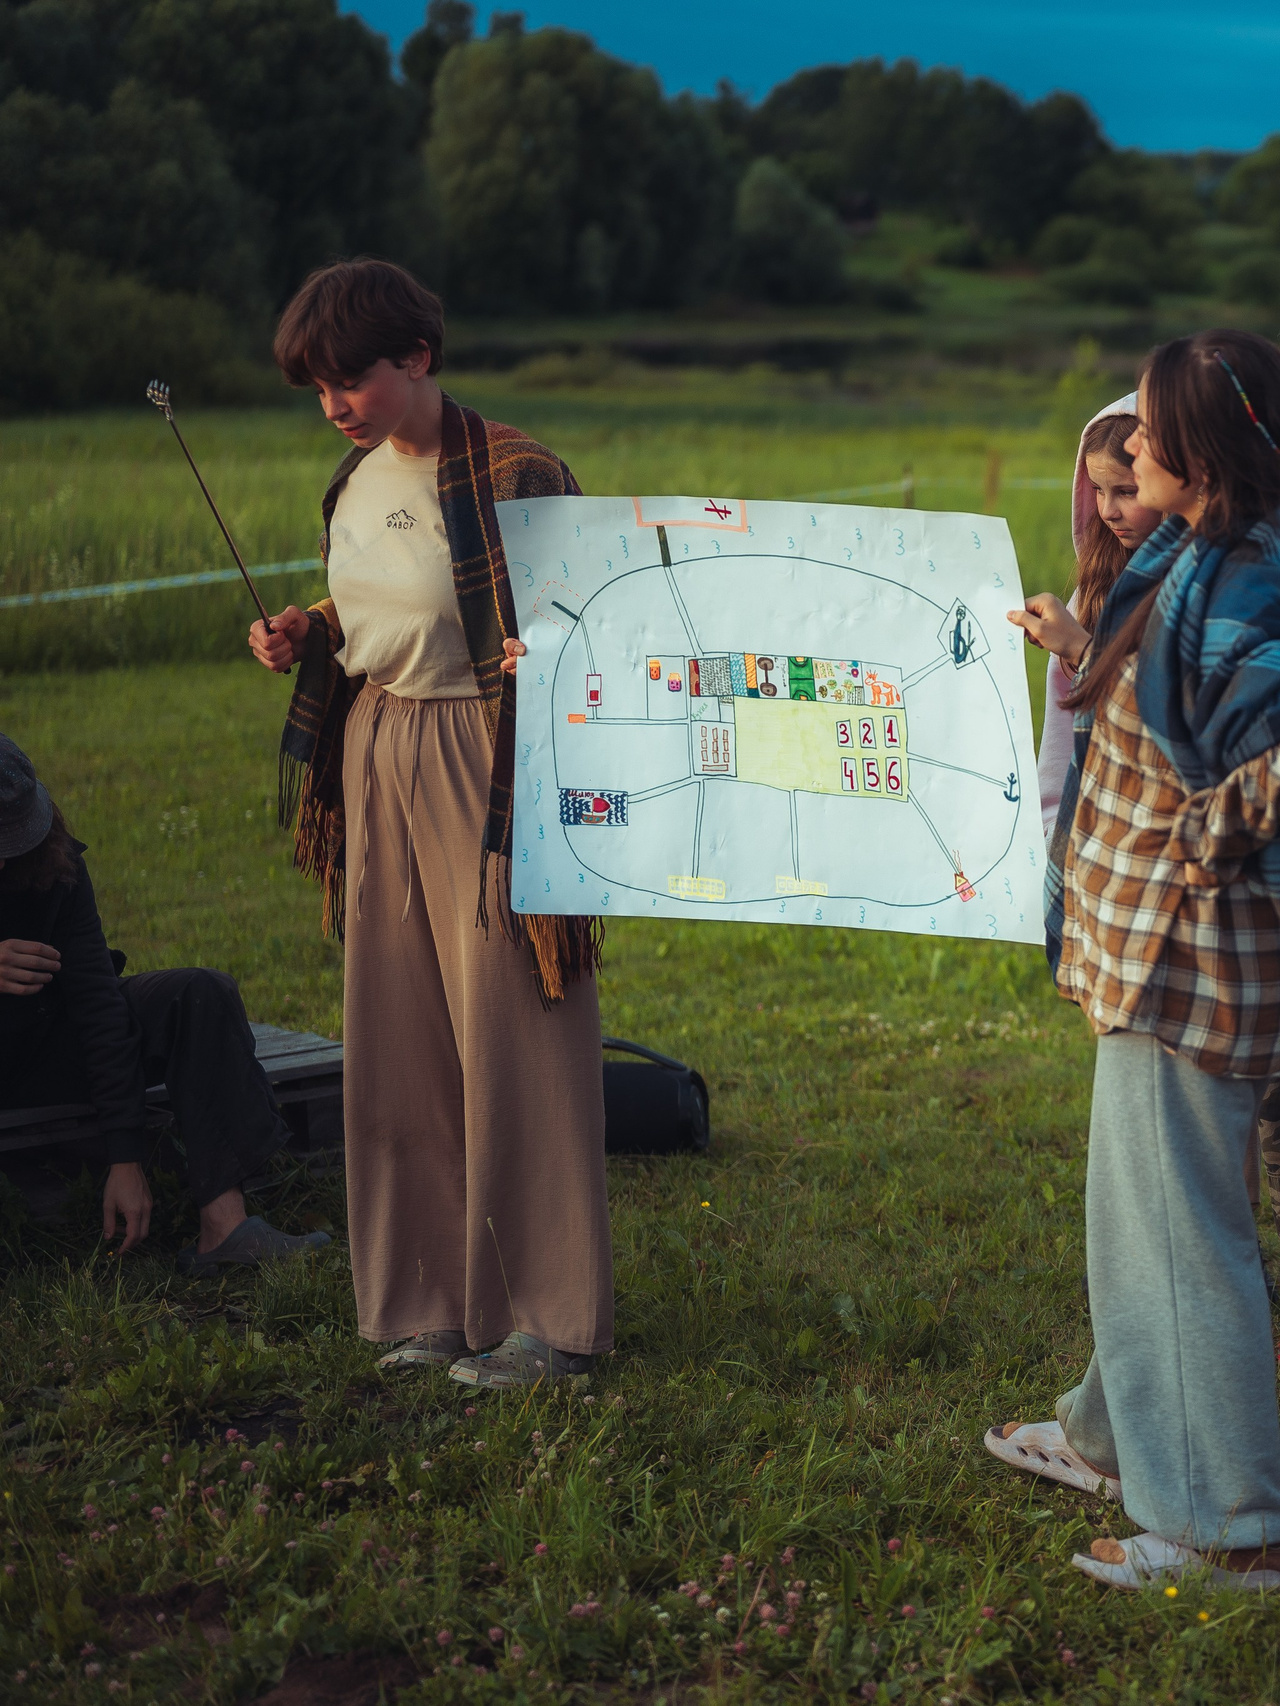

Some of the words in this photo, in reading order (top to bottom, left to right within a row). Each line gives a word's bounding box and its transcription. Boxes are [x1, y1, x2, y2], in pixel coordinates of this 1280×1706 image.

[386, 520, 415, 530] ФАВОР
[839, 723, 850, 744] 3
[862, 722, 873, 745] 2
[886, 719, 898, 743] 1
[843, 761, 855, 790] 4
[866, 762, 879, 787] 5
[887, 761, 901, 790] 6
